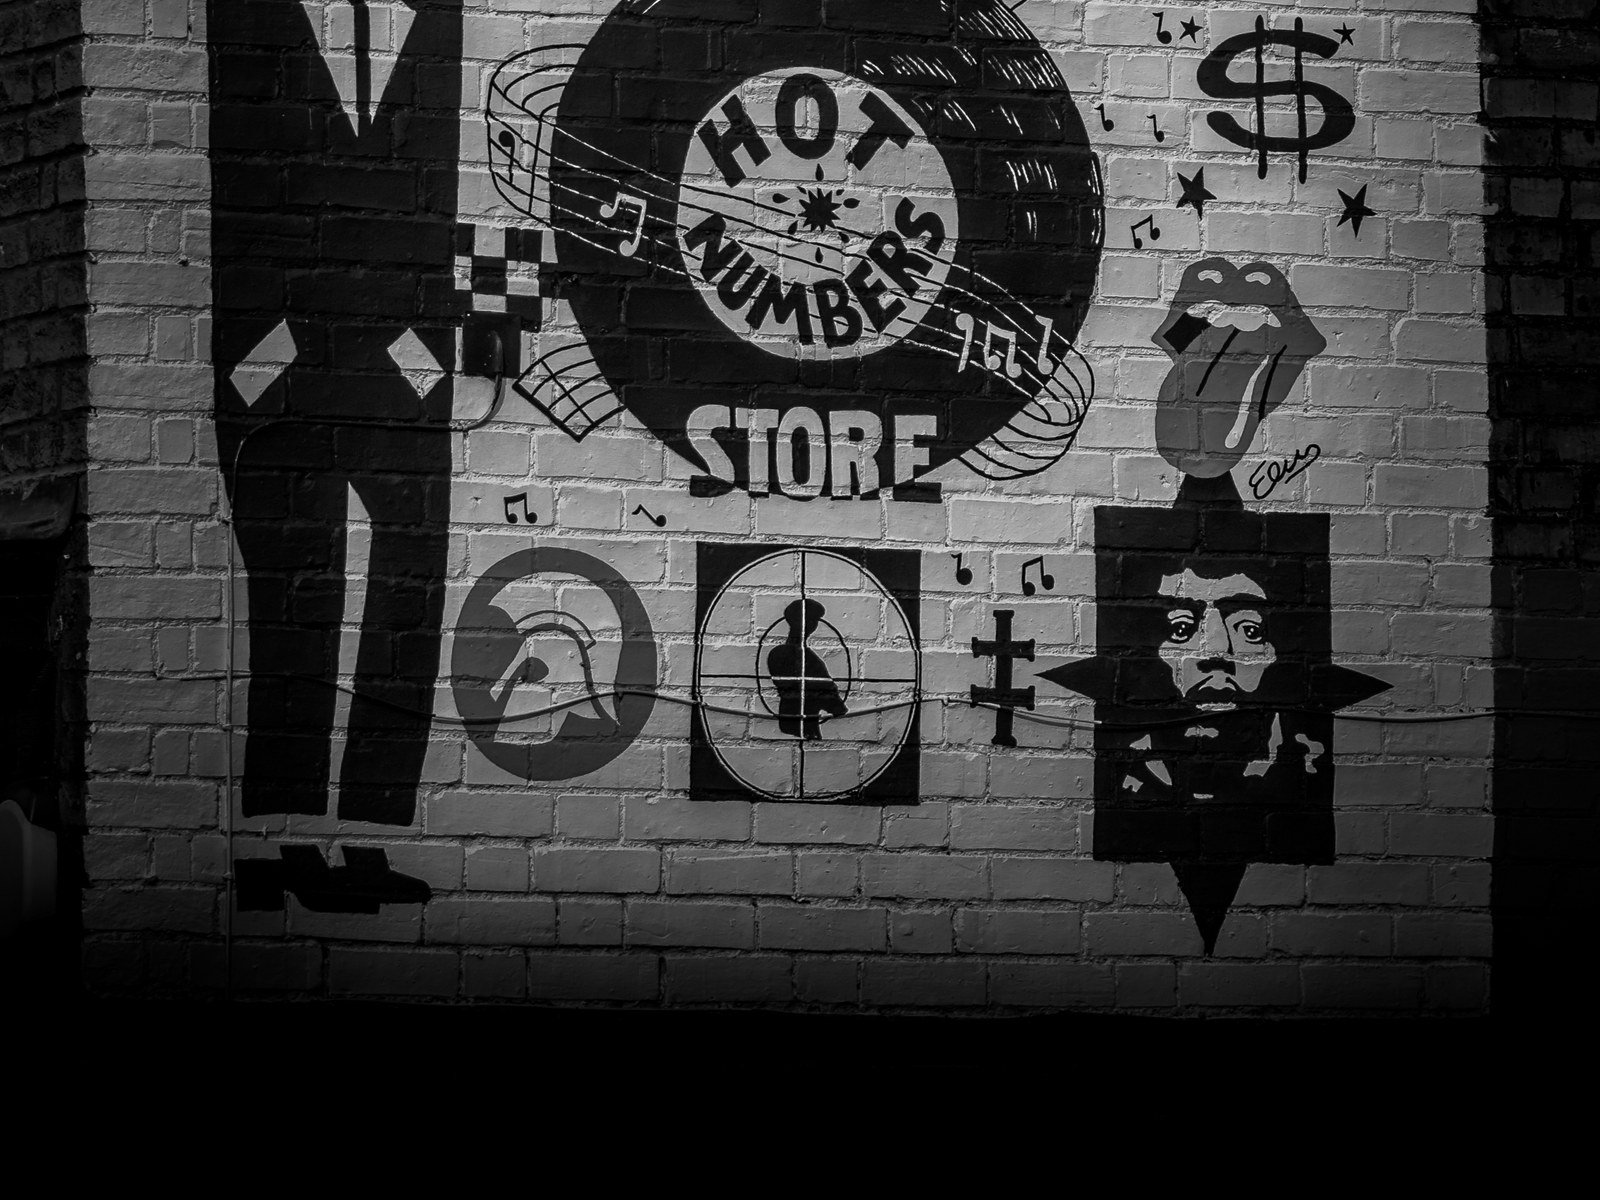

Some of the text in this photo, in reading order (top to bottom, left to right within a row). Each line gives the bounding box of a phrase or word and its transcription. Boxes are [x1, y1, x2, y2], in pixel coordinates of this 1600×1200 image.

[697, 73, 915, 188] HOT
[683, 196, 946, 349] NUMBERS
[686, 403, 942, 503] STORE
